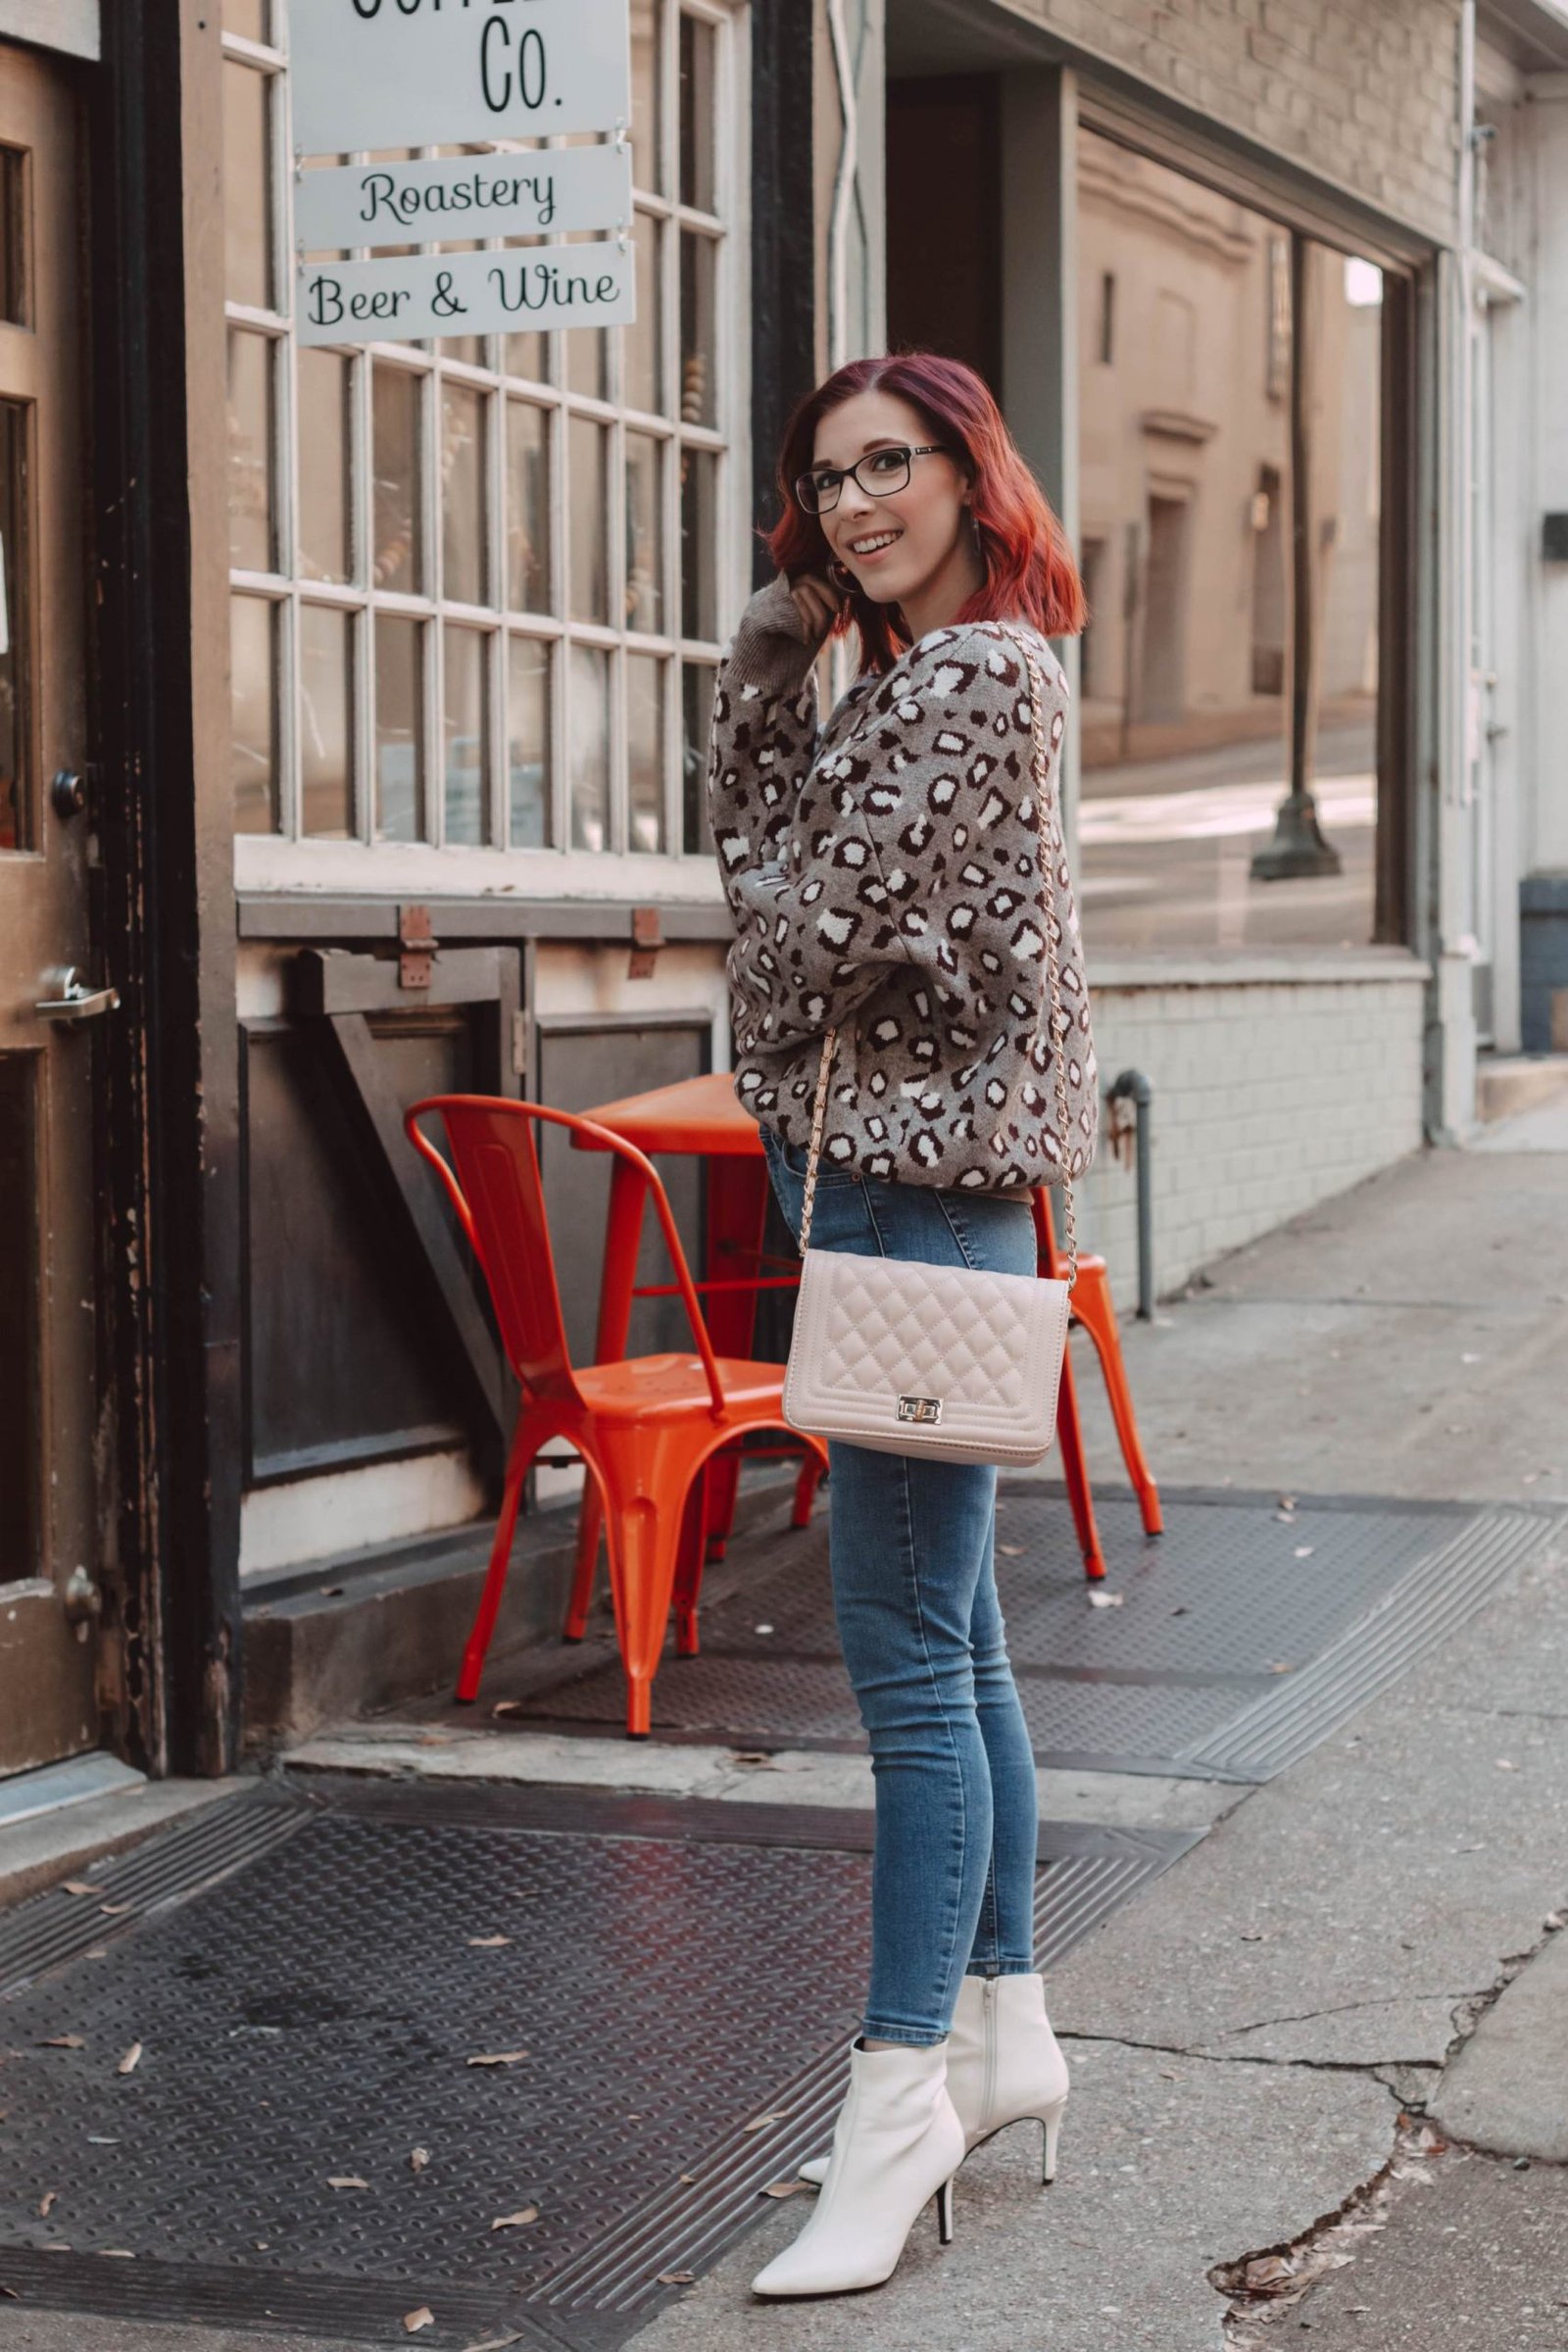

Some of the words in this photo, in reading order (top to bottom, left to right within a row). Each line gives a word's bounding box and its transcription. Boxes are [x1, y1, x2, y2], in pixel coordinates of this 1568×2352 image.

[360, 172, 556, 225] Roastery
[308, 275, 411, 325] Beer
[430, 271, 467, 317] &
[488, 264, 620, 312] Wine
